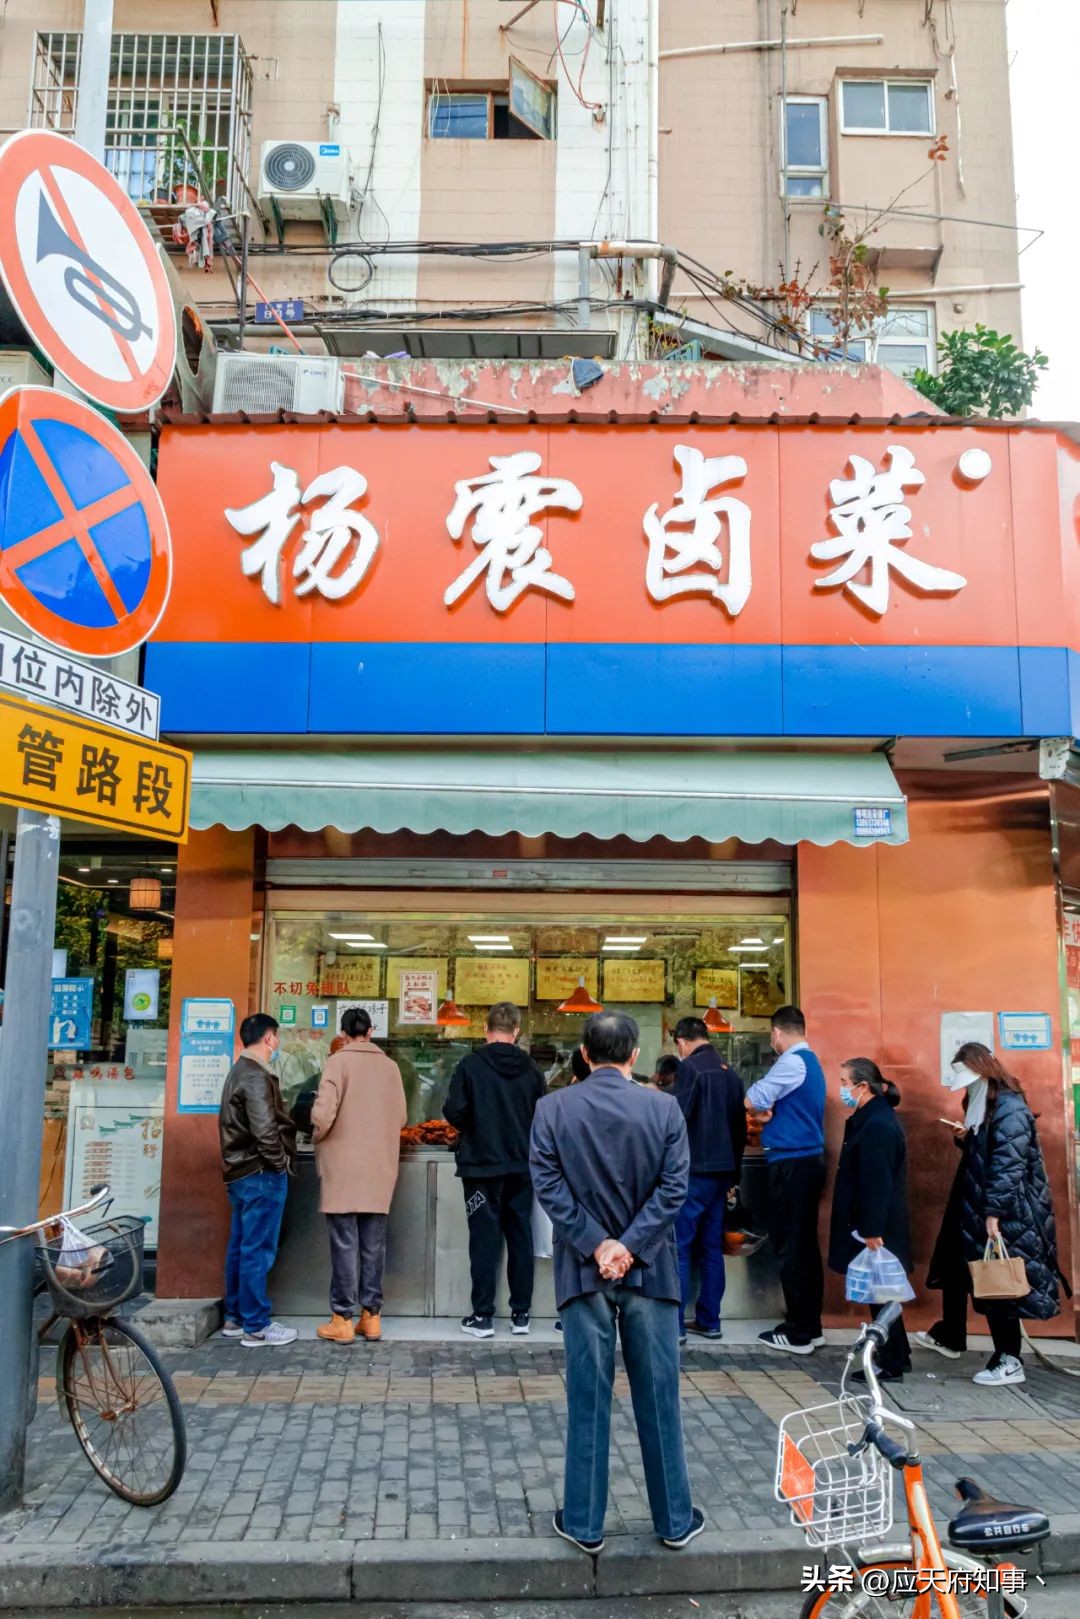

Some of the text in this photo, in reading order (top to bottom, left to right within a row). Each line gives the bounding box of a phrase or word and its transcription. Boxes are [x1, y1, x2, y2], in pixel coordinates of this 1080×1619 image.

[224, 445, 967, 617] 杨震卤菜
[0, 643, 153, 730] 位内除外
[17, 723, 173, 819] 管路段
[983, 1523, 1030, 1537] 公共自行车
